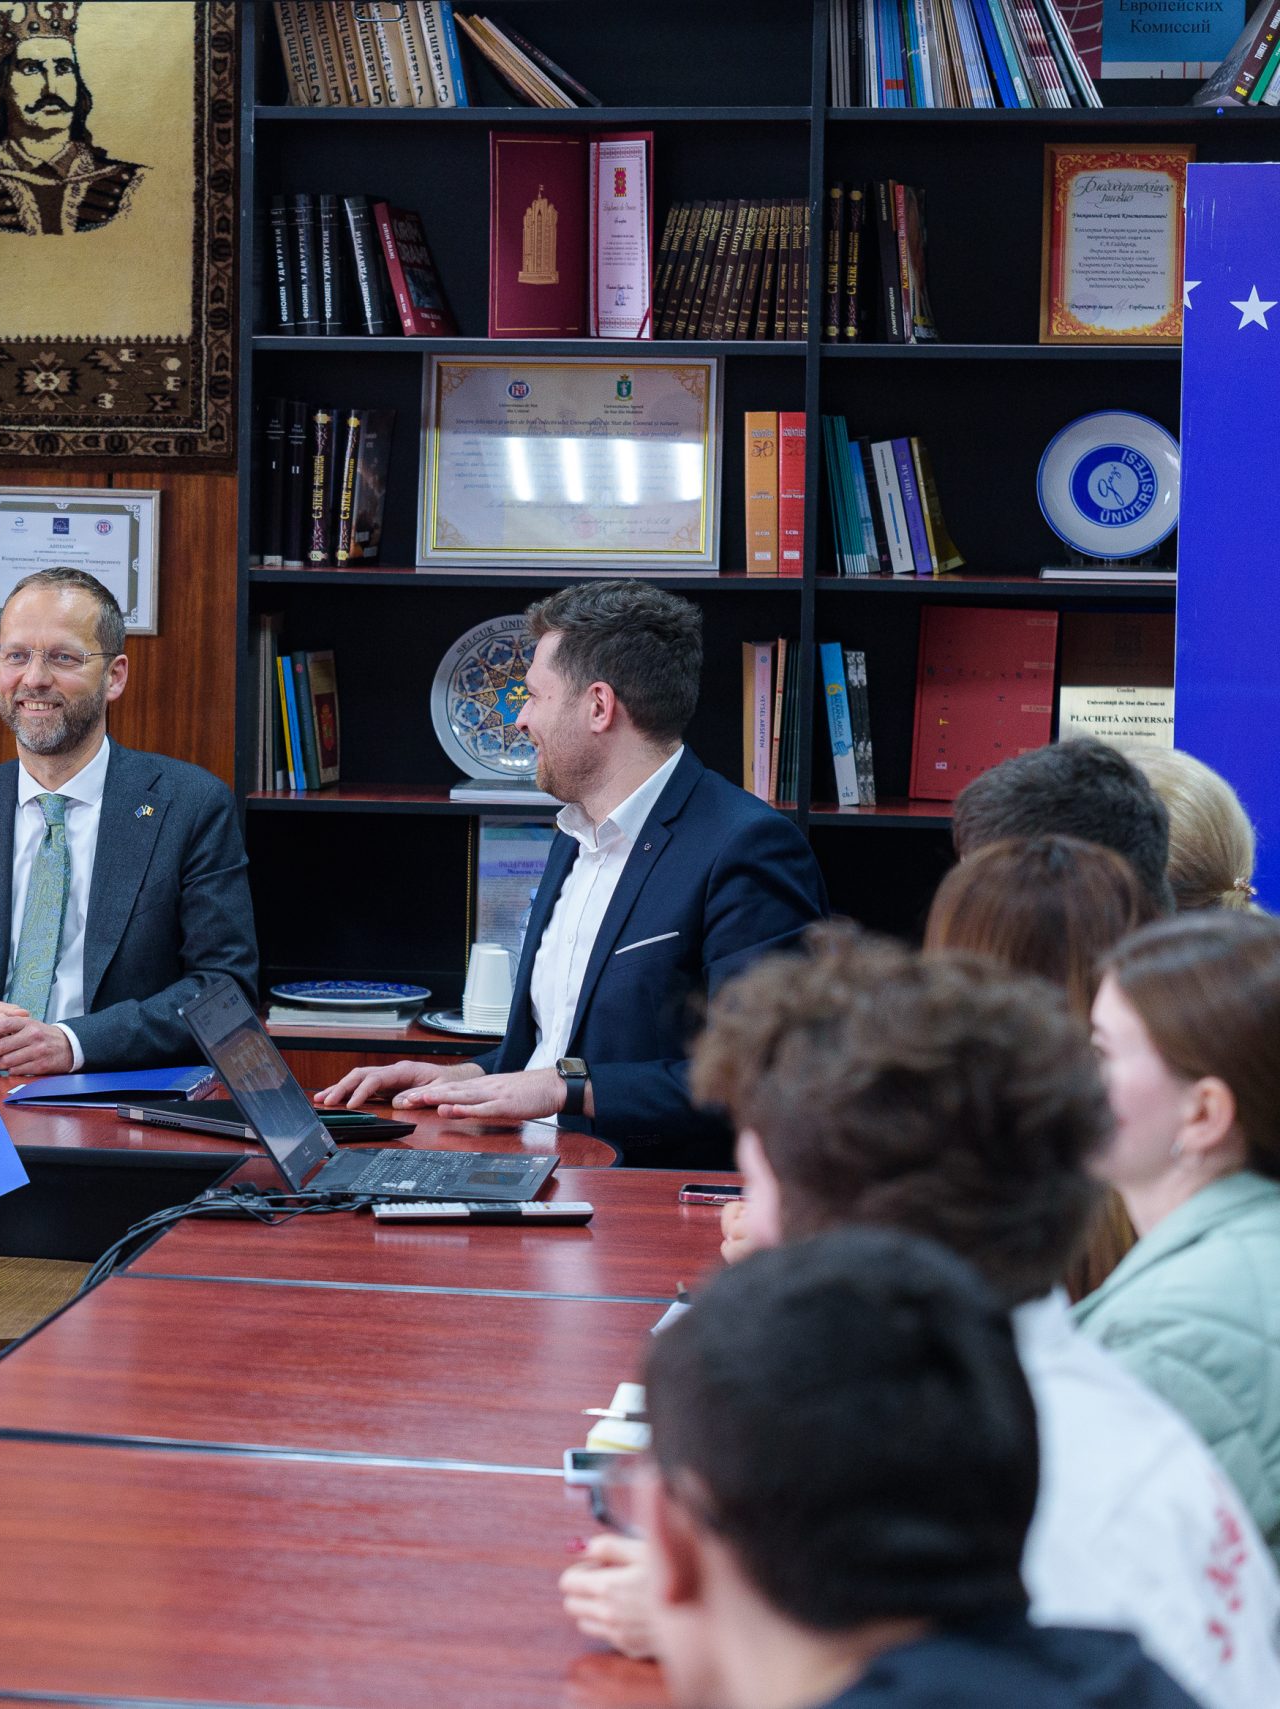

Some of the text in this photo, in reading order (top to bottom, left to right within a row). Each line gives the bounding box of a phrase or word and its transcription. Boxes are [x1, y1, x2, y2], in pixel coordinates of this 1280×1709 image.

[1130, 19, 1210, 34] Комиссий
[1254, 42, 1268, 60] TURKEY
[311, 86, 321, 103] 2
[332, 87, 342, 104] 3
[372, 86, 382, 105] 5
[439, 84, 449, 103] 8
[275, 228, 288, 322] ФЕНОМЕН УДМУРТИИ
[298, 228, 309, 319] ФЕНОМЕН УДМУРТИИ
[322, 230, 332, 319] ФЕНОМЕН УДМУРТИИ
[355, 230, 372, 318] ФЕНОМЕН УДМУРТИИ
[828, 263, 839, 285] STERE
[847, 264, 858, 287] STERE
[291, 466, 300, 474] II
[1100, 450, 1154, 523] ÜNİVERSİTESİ
[312, 488, 323, 511] STERE
[341, 489, 352, 512] STERE
[1070, 714, 1174, 724] PLACHETĂ ANIVERSAR
